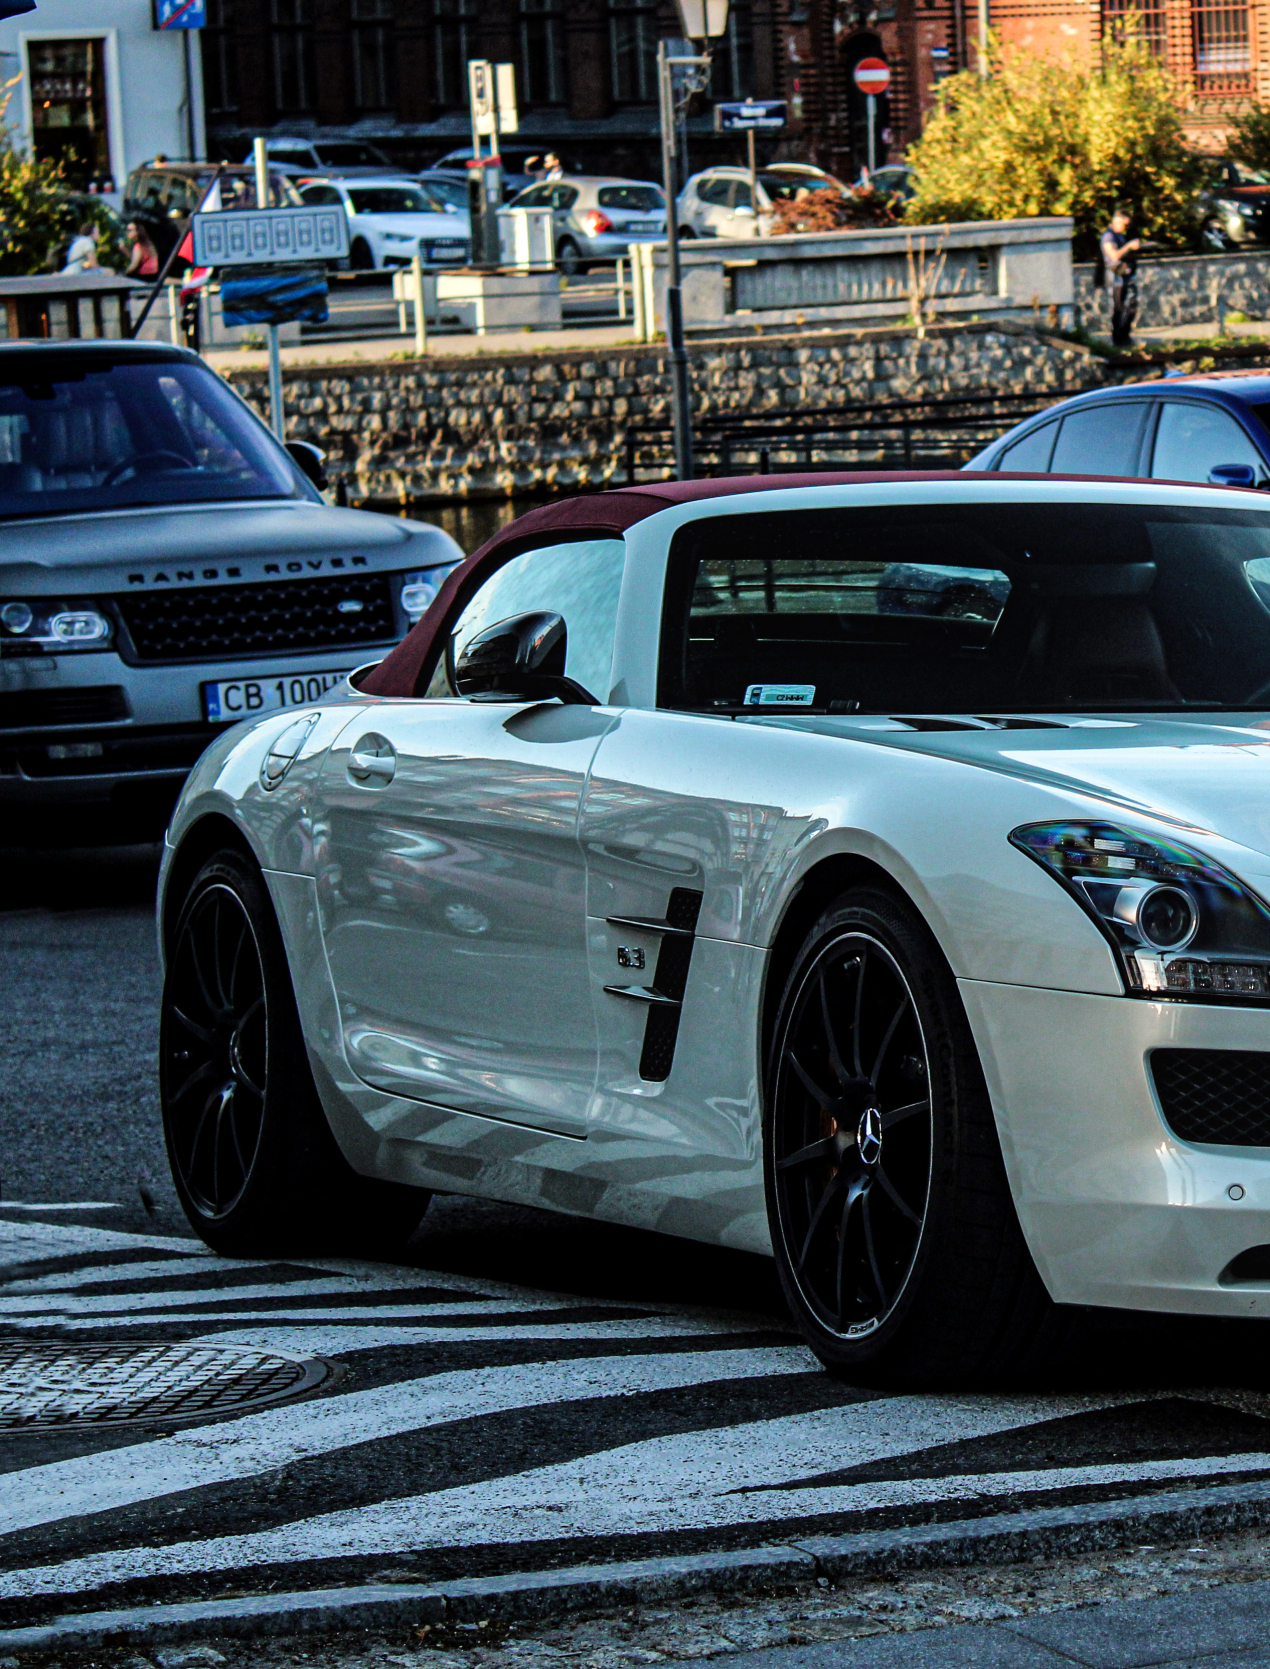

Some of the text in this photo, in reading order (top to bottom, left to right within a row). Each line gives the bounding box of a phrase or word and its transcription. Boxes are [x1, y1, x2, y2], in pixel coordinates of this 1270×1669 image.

[127, 555, 368, 585] RANGE ROVER
[224, 674, 346, 712] CB 100H
